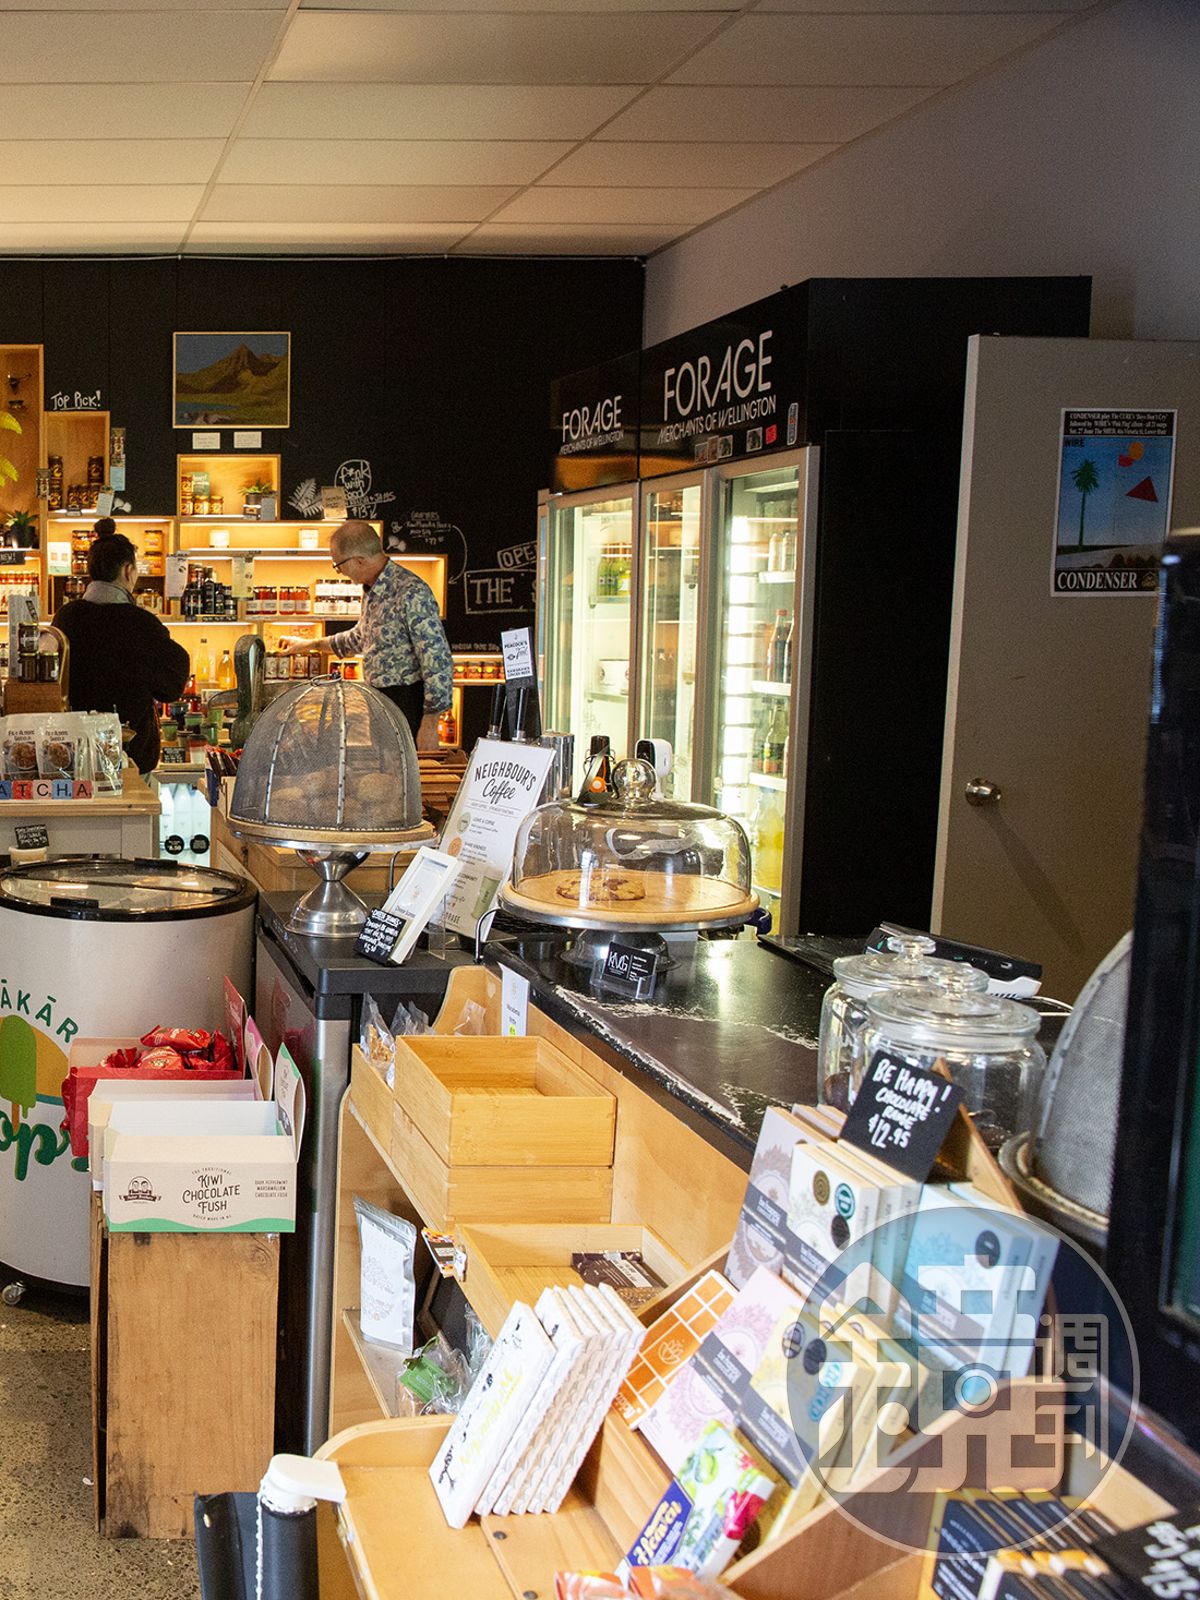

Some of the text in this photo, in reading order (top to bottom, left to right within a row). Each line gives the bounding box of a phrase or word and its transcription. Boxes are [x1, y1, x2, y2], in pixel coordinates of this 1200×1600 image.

[664, 330, 773, 421] FORAGE
[50, 391, 70, 410] TOP
[562, 395, 622, 442] FORAGE
[657, 395, 777, 445] MERCHANTS OF WELLINGTON
[559, 436, 586, 455] MERCHANTS
[592, 430, 624, 448] WELLINGTON
[502, 544, 537, 568] OPE
[470, 577, 515, 604] THE
[1057, 571, 1138, 590] CONDENSER
[474, 761, 537, 791] NEIGHBOUR'S
[482, 778, 516, 805] Coffee
[872, 1058, 897, 1084] BE
[197, 1174, 223, 1188] KIWI
[182, 1184, 241, 1204] CHOCOLATE
[198, 1200, 227, 1214] FUSH
